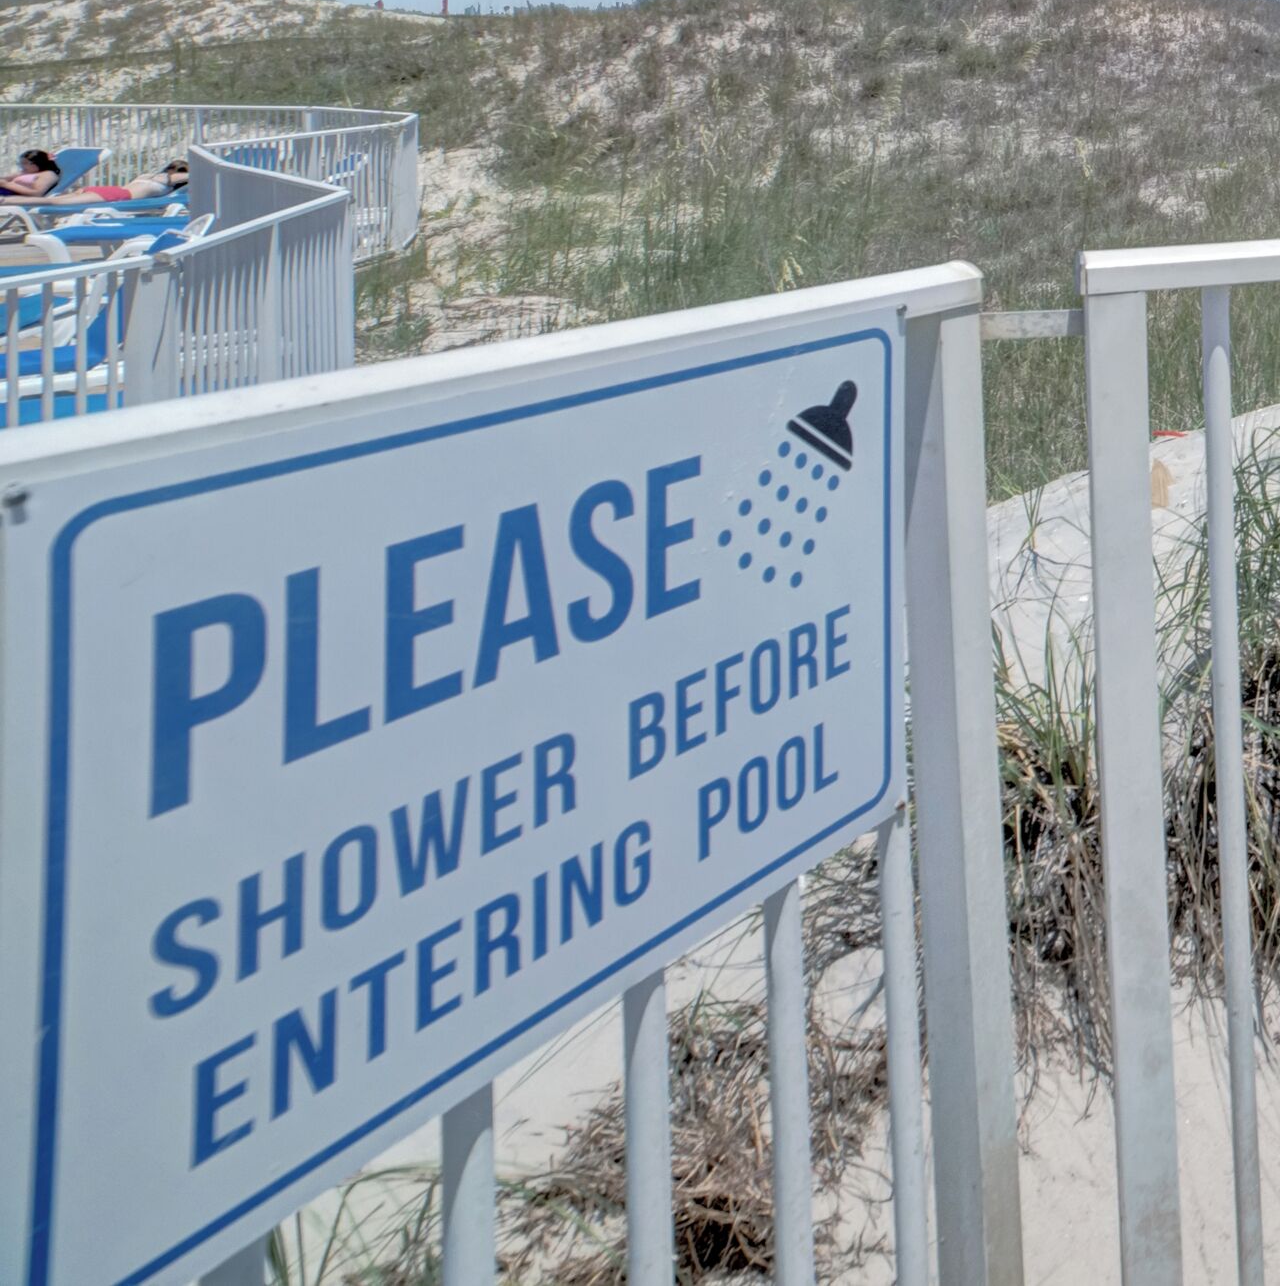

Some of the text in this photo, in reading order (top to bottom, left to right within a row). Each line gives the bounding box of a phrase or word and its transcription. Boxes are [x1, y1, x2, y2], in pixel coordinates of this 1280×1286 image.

[149, 456, 701, 819] PLEASE
[149, 605, 851, 1019] SHOWER BEFORE
[190, 724, 839, 1169] ENTERING POOL
